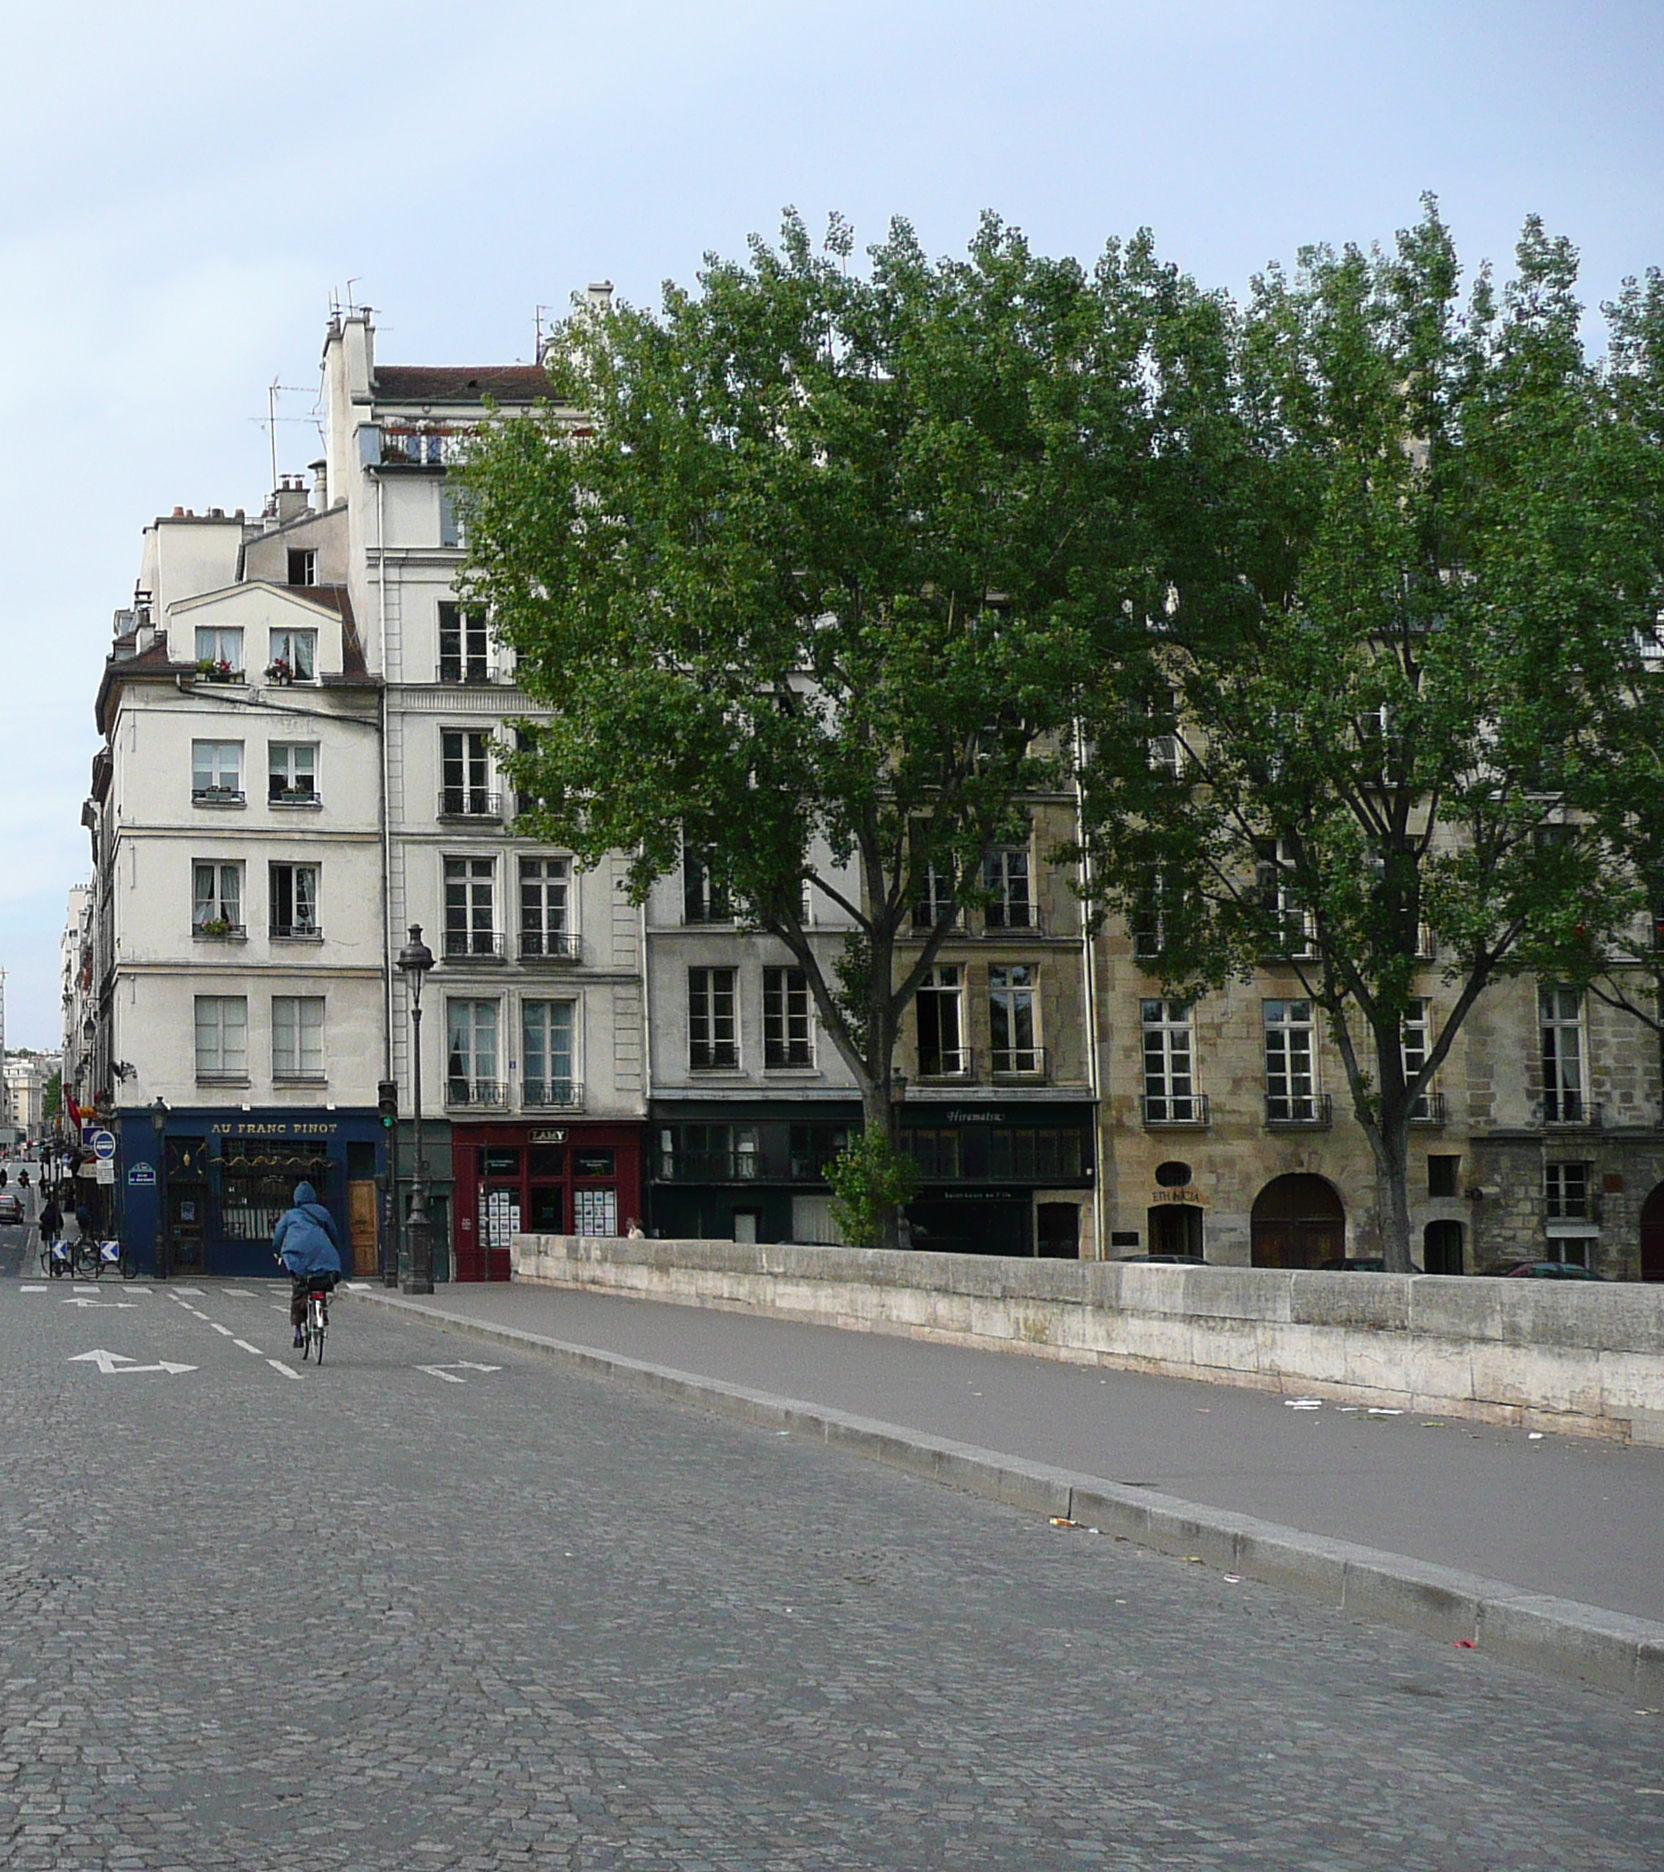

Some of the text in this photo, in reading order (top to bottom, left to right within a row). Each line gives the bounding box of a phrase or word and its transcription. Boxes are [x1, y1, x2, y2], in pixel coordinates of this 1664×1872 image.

[211, 1124, 338, 1133] AU FRANC PINOT
[532, 1131, 565, 1140] LAMY
